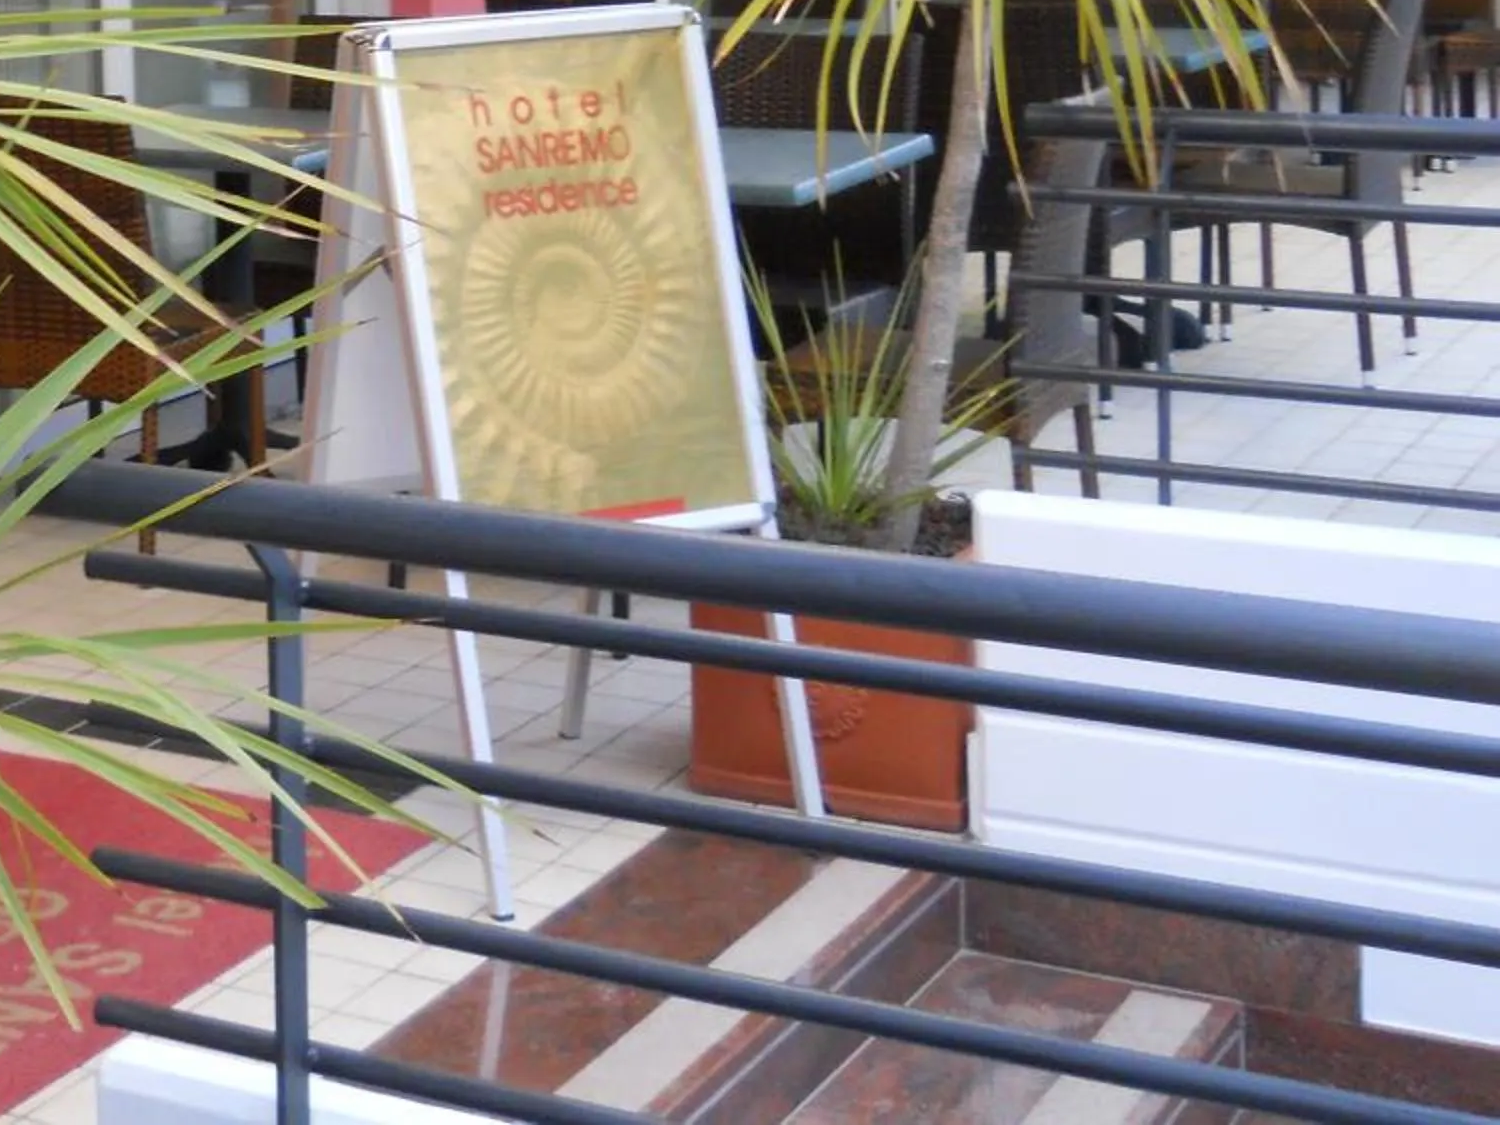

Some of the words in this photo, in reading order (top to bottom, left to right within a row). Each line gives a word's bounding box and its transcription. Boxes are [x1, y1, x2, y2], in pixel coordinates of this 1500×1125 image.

[469, 79, 628, 127] hotel
[475, 125, 632, 174] SANREMO
[484, 175, 639, 219] residence
